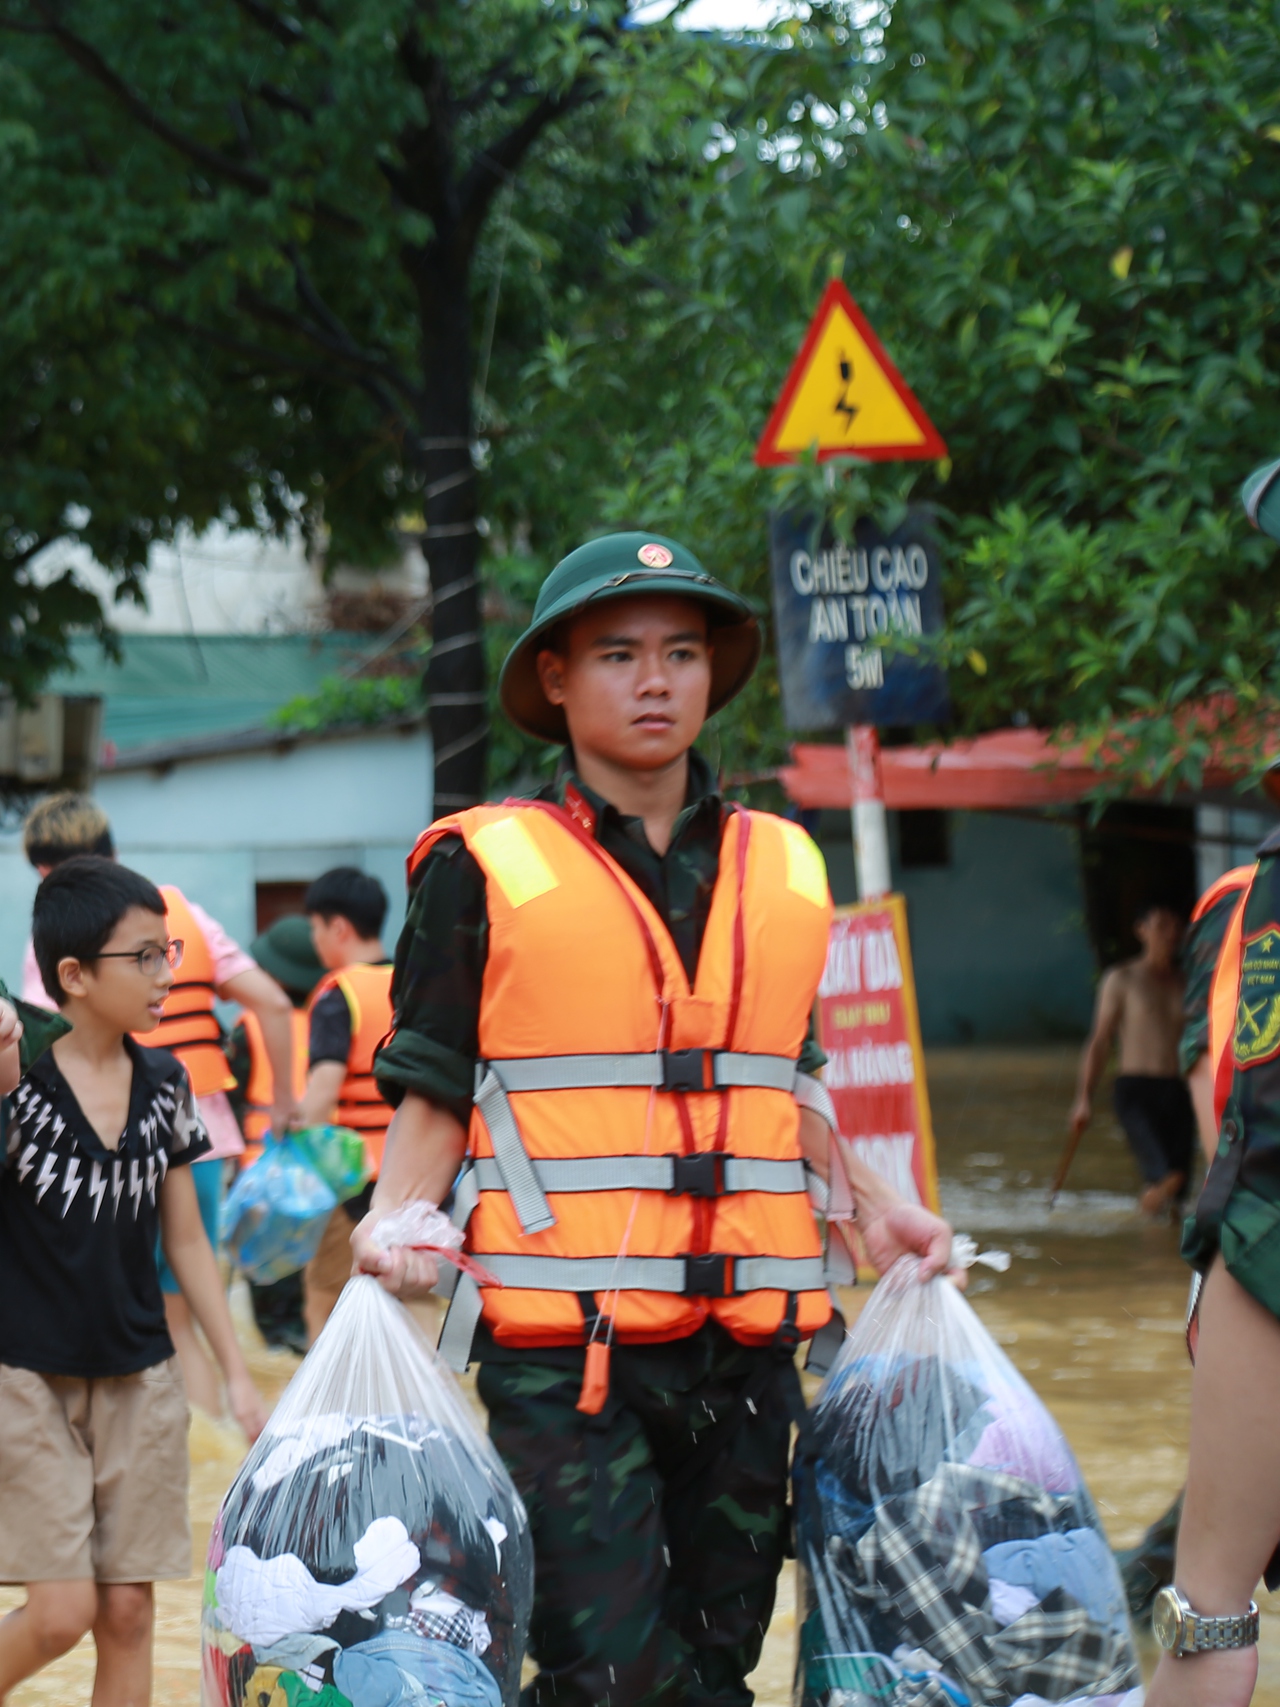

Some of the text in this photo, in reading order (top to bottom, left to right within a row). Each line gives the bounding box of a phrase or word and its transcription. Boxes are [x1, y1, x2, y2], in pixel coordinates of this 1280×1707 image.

[871, 543, 928, 592] CAO
[809, 596, 849, 643] AN
[845, 644, 884, 690] 5M
